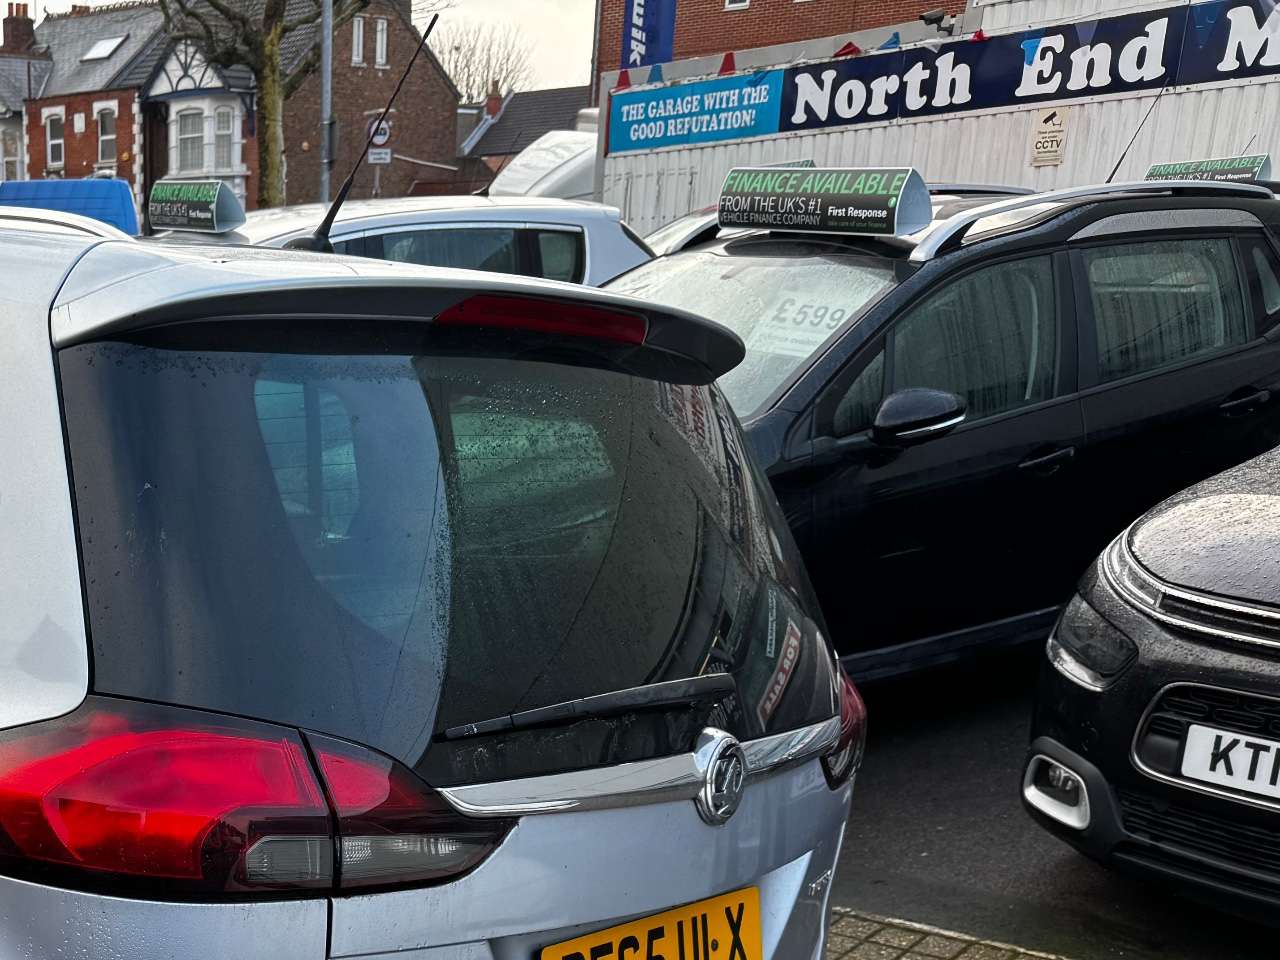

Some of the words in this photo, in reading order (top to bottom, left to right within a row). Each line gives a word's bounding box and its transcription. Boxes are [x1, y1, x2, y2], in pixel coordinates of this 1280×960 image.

[791, 51, 972, 125] North
[1014, 17, 1169, 97] End
[621, 103, 645, 122] THE
[647, 95, 701, 118] GARAGE
[704, 90, 739, 114] WITH
[742, 84, 769, 105] THE
[630, 121, 665, 141] GOOD
[667, 109, 757, 137] REPUTATION!
[1036, 139, 1062, 149] CCTV
[1148, 163, 1199, 175] FINANCE
[1199, 156, 1264, 170] AVAILABLE
[723, 172, 802, 193] FINANCE
[798, 173, 908, 195] AVAILABLE
[719, 195, 751, 212] FROM
[753, 196, 777, 213] THE
[777, 196, 807, 213] UK'S
[807, 197, 822, 214] #1
[827, 206, 846, 217] First
[847, 206, 888, 220] Response
[750, 213, 782, 224] FINANCE
[782, 213, 822, 226] COMPANY
[772, 298, 845, 330] £599
